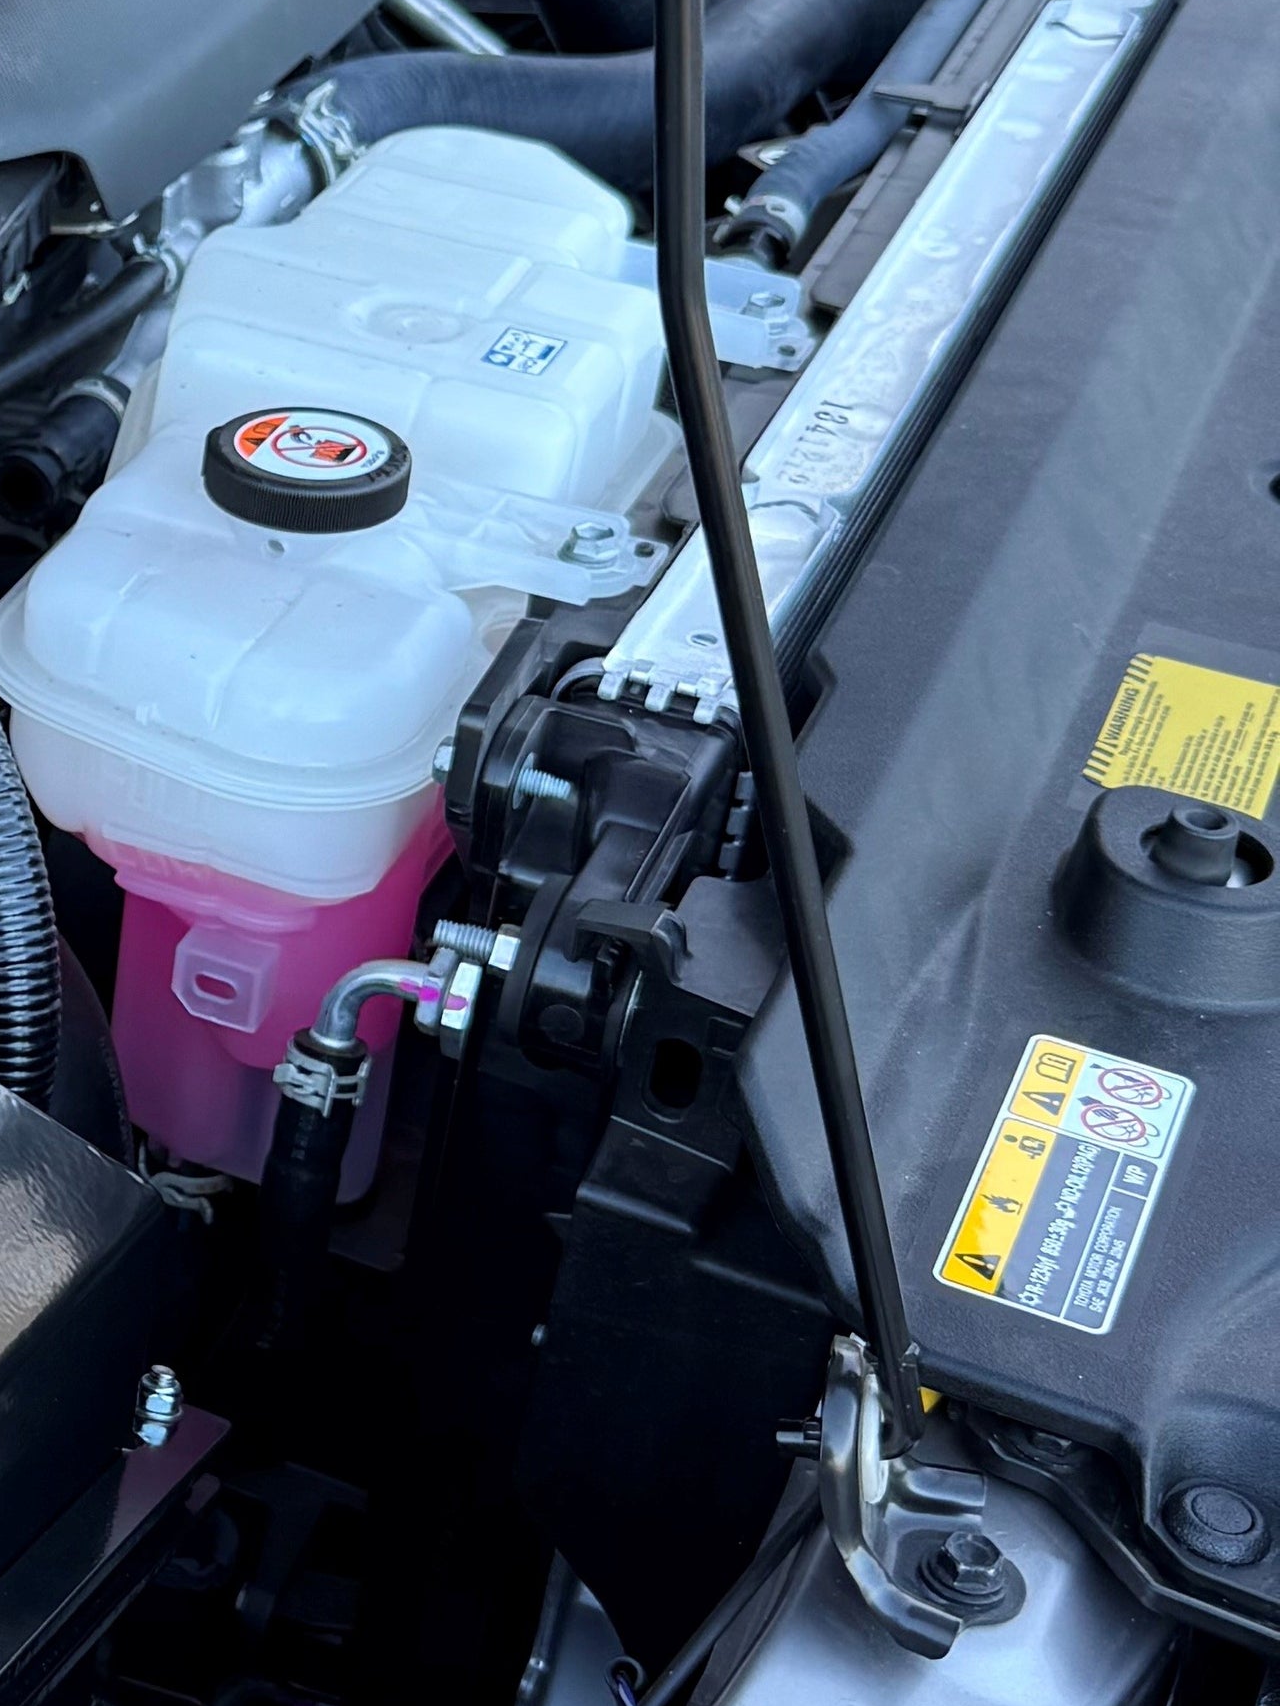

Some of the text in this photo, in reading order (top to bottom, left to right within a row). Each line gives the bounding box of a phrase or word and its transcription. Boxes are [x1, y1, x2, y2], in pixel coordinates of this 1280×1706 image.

[1102, 687, 1140, 741] WARNING
[1122, 1164, 1149, 1187] WP
[1073, 1205, 1124, 1308] TOYOTA MOTOR CORPORATION
